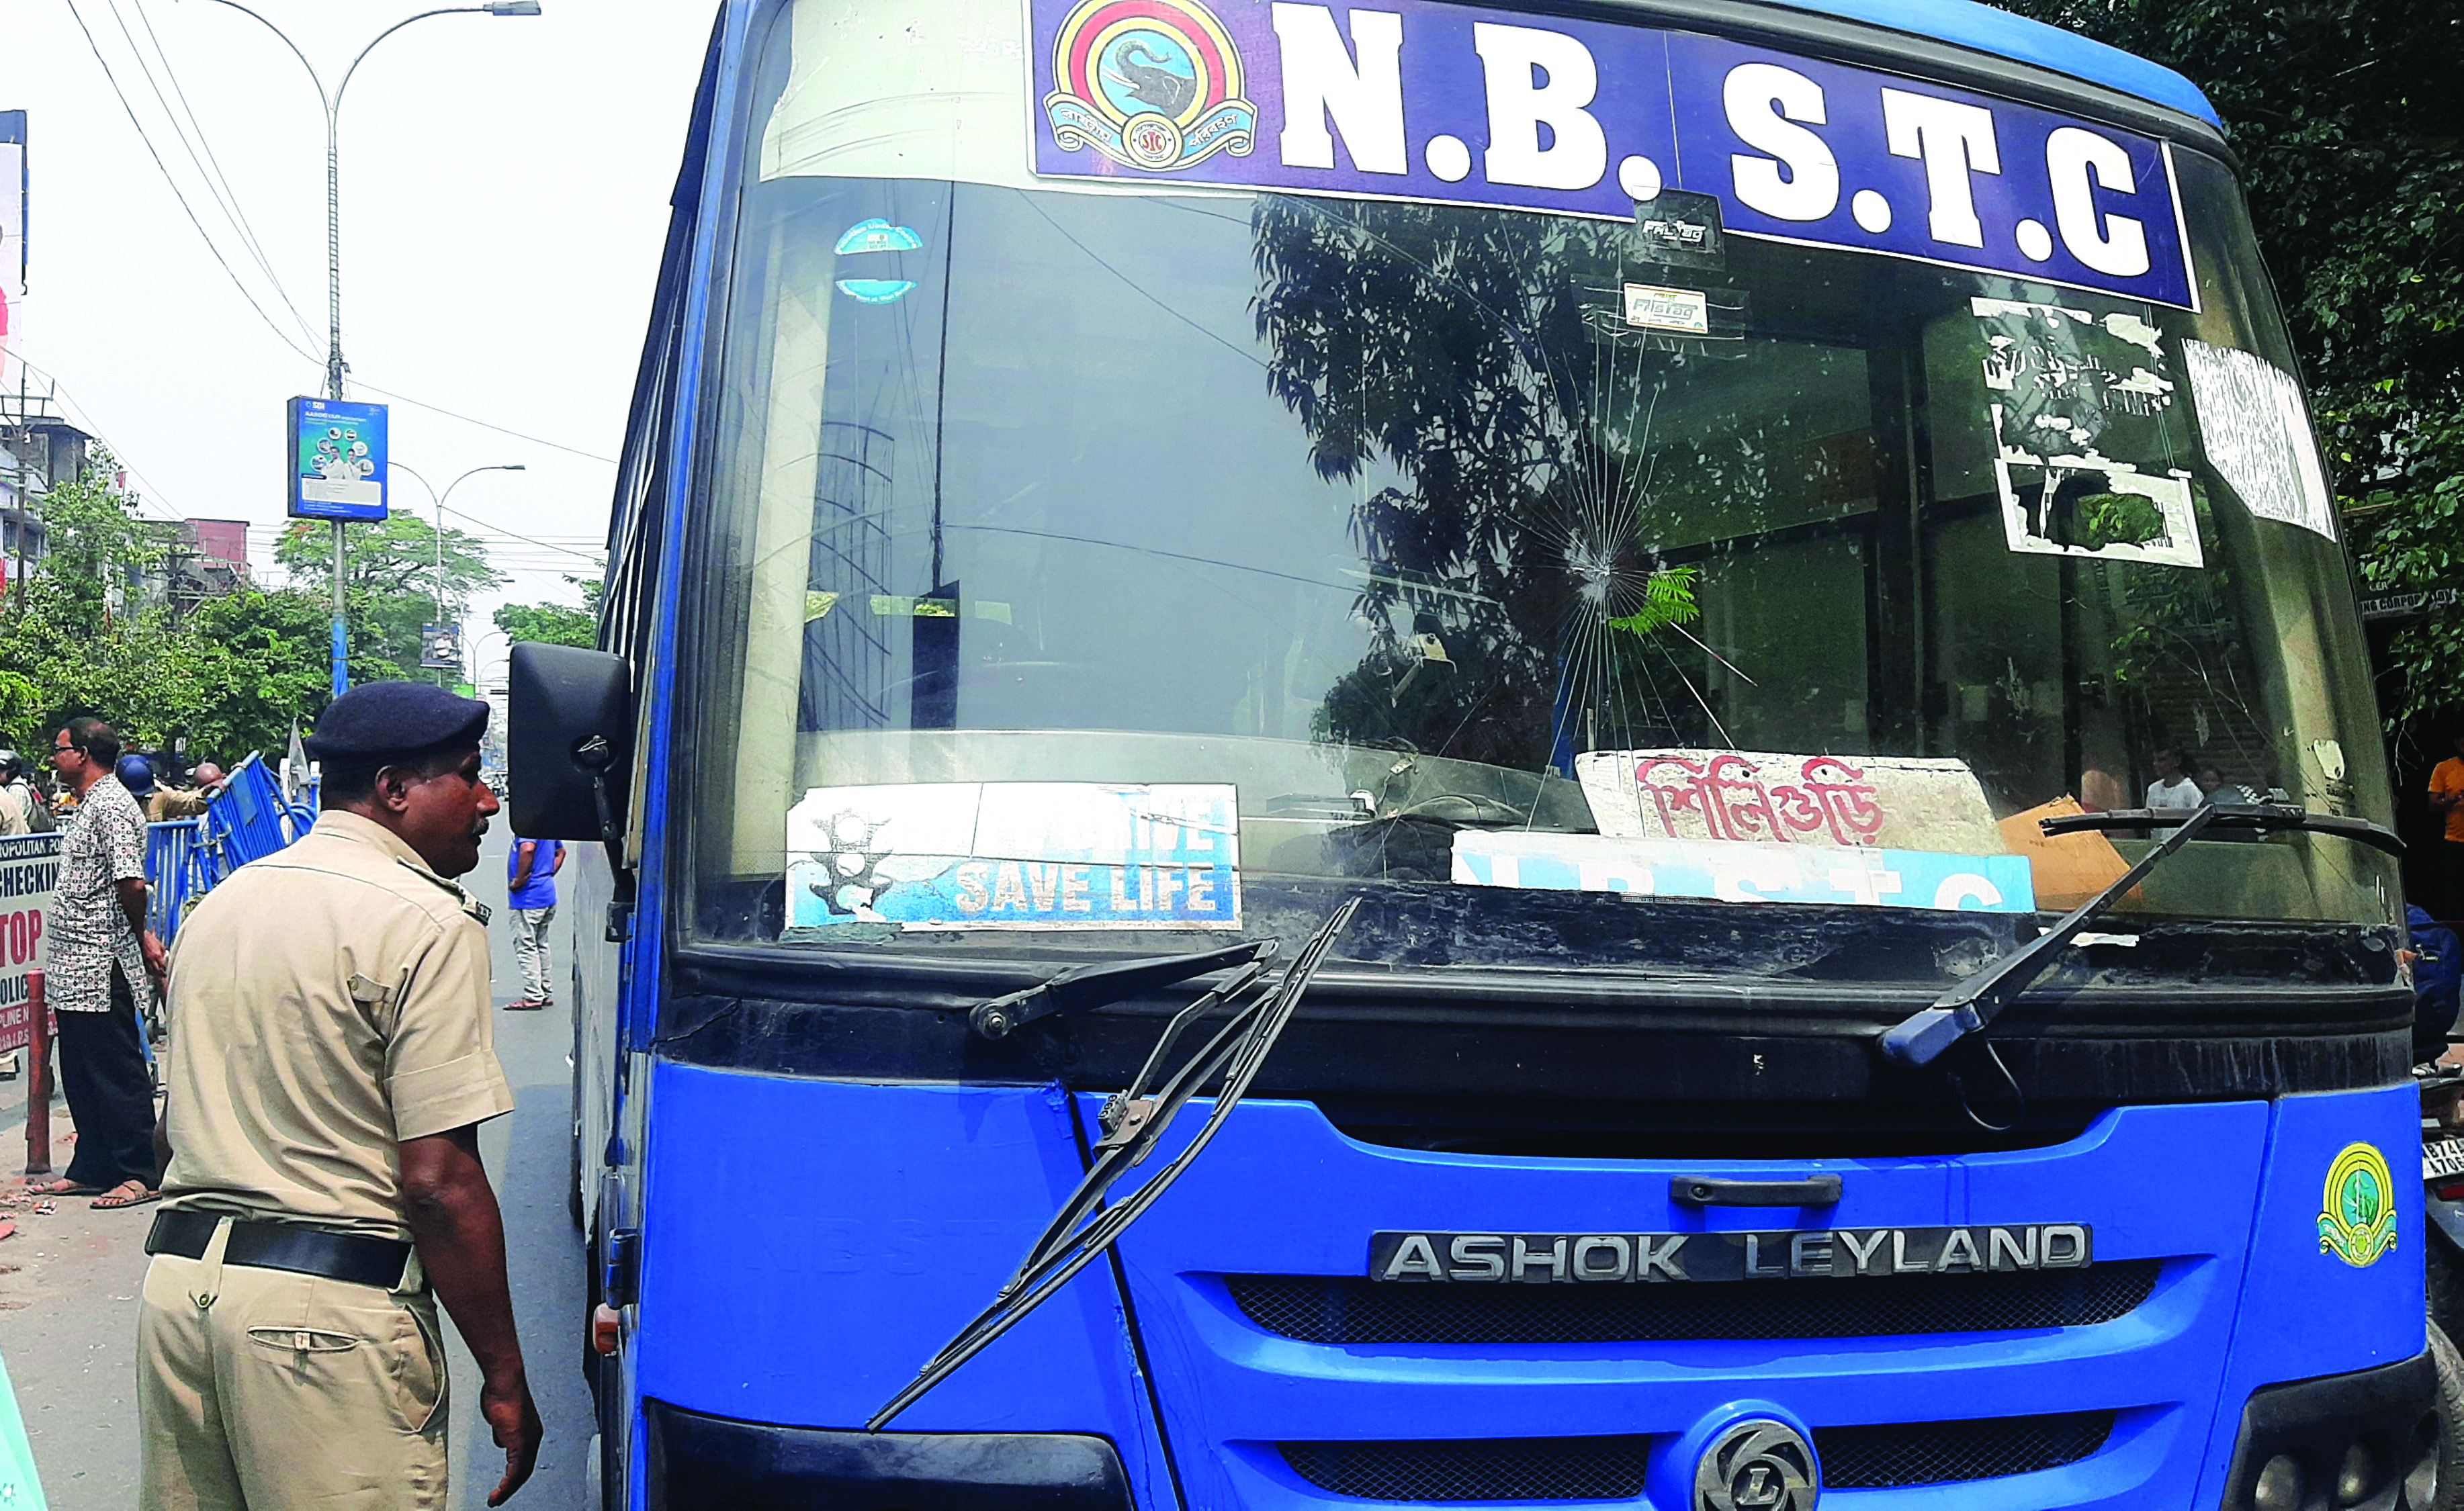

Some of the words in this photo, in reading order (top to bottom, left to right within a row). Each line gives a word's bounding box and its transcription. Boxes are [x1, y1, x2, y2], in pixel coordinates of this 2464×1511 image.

[0, 862, 60, 898] HECKIN
[955, 861, 1091, 913] SAVE
[1110, 862, 1217, 911] LIFE
[1380, 1234, 1691, 1283] ASHOK
[1746, 1225, 2086, 1276] LEYLAND
